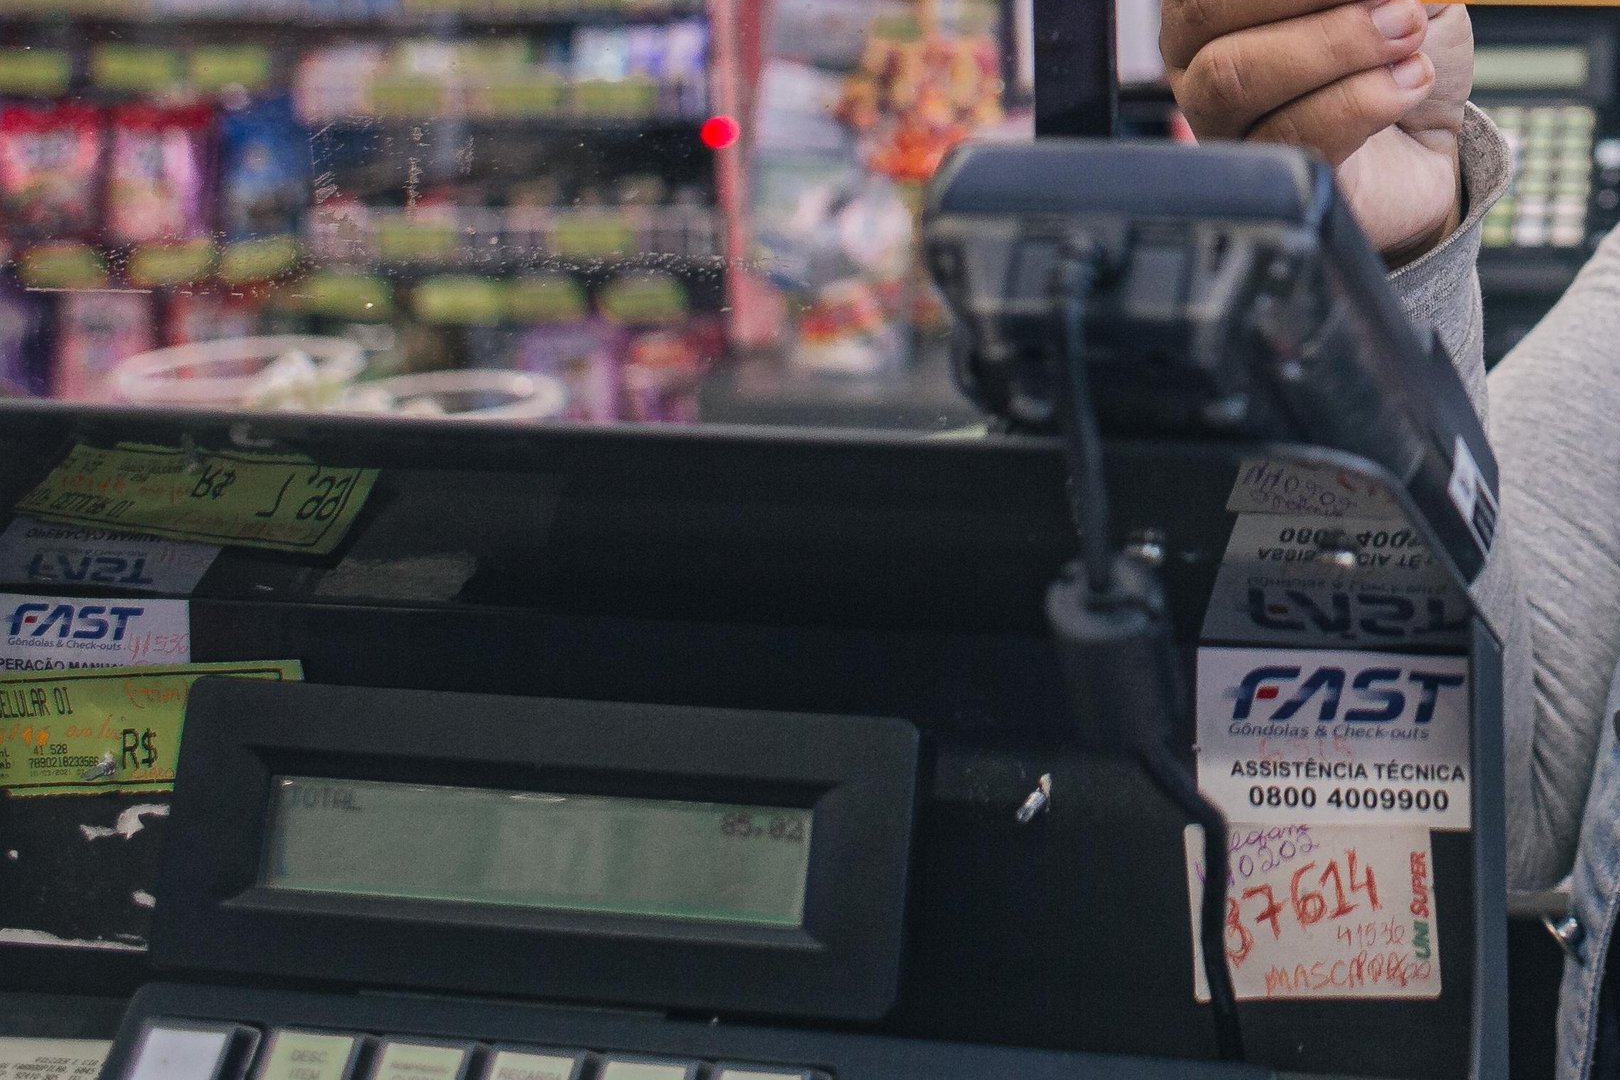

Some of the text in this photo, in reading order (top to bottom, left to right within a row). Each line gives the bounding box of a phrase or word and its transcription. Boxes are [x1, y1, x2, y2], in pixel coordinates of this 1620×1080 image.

[10, 602, 145, 641] FAST
[8, 635, 122, 651] Gôndolas & Check-outs
[53, 686, 73, 715] OI
[1230, 665, 1465, 722] FAST
[1228, 720, 1431, 741] Gôndolas & Check-outs
[50, 743, 68, 756] 528
[122, 727, 159, 770] R$
[1230, 755, 1466, 783] ASSISTÊNCIA TÉCNICA
[1248, 786, 1450, 812] 0800 4009900
[1223, 846, 1384, 970] 37614
